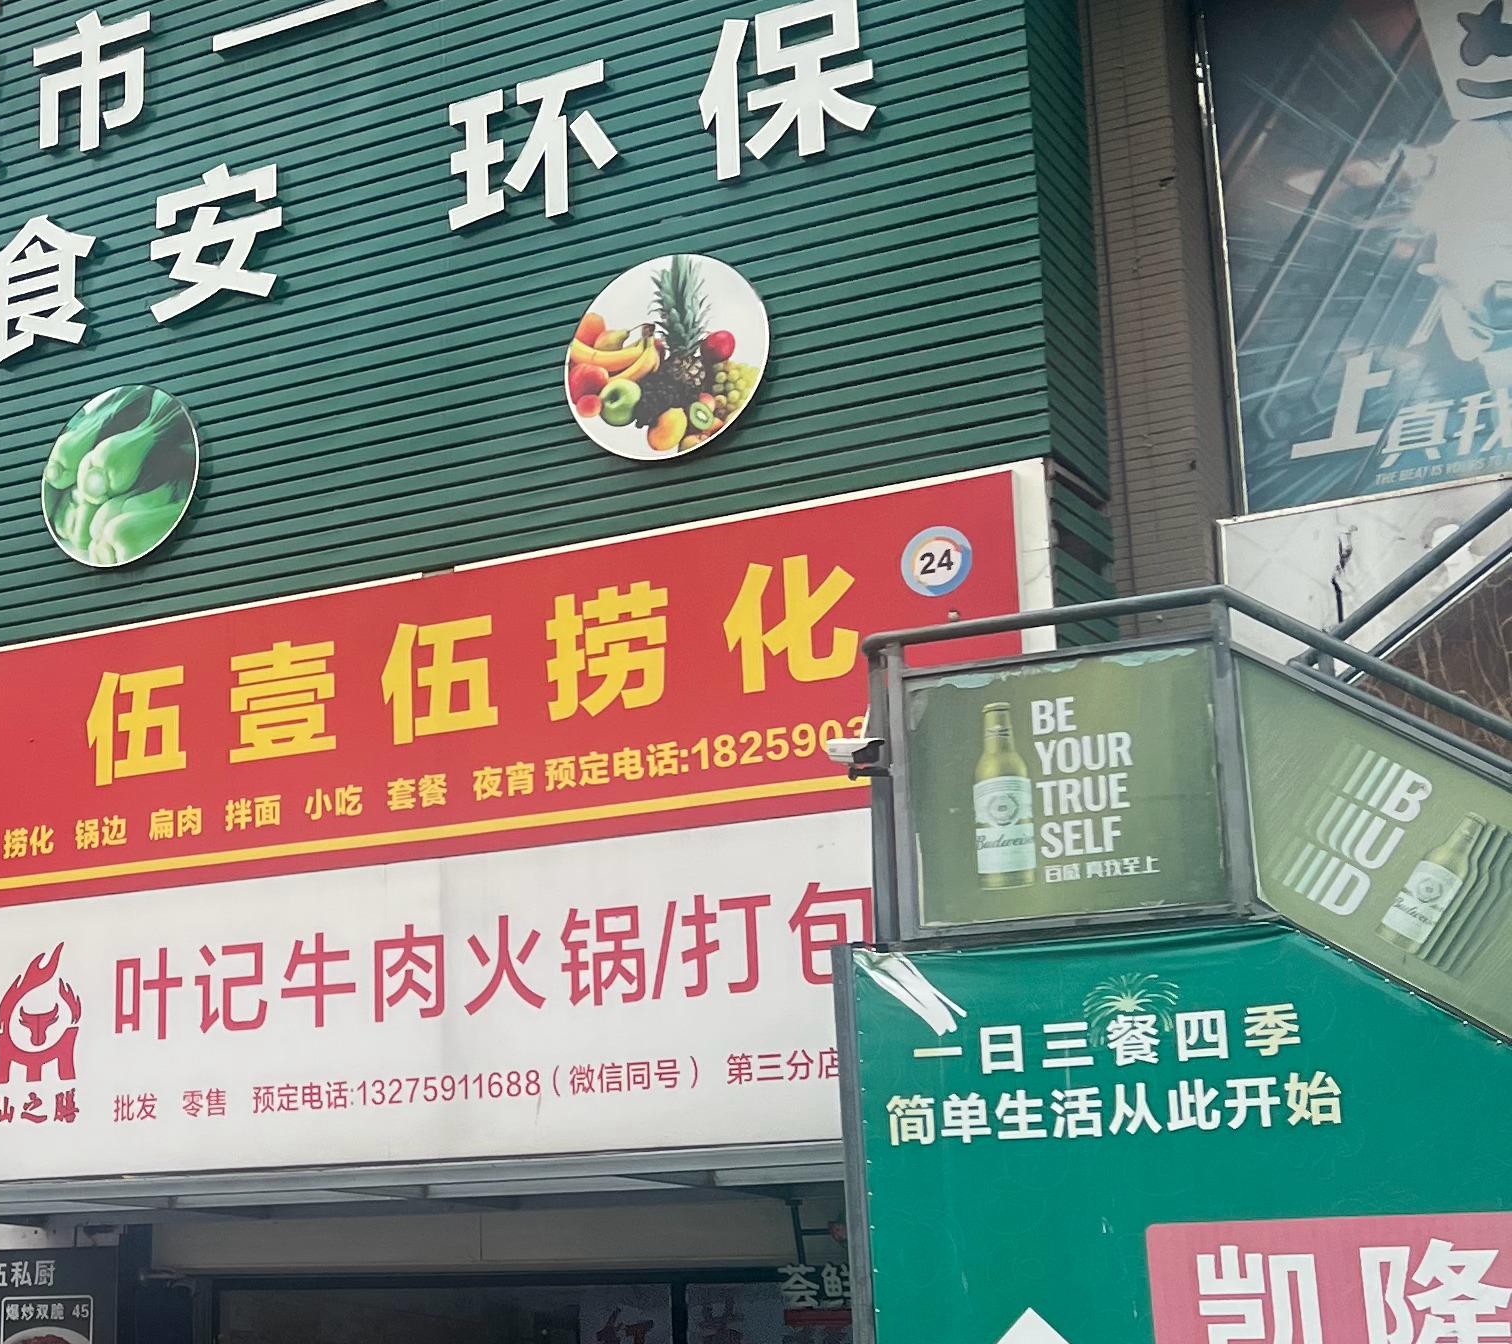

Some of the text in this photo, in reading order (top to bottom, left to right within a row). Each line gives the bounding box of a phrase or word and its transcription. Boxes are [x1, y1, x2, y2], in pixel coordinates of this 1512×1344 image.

[920, 548, 954, 575] 24
[86, 554, 859, 786] 伍壹伍捞化
[1031, 696, 1076, 735] BE
[1034, 732, 1133, 775] YOUR
[3, 825, 54, 859] 捞化
[75, 814, 127, 850] 锅边
[149, 805, 202, 840] 扁肉
[225, 794, 281, 832] 拌面
[305, 784, 363, 821] 小吃
[387, 773, 447, 810] 套餐
[472, 761, 535, 801] 夜宵
[1036, 773, 1130, 816] TRUE
[1040, 816, 1122, 858] SELF
[914, 1003, 1301, 1074] 一日三餐四季
[113, 1093, 157, 1122] 批发
[183, 1088, 227, 1118] 零售
[886, 1070, 1342, 1146] 简单生活从此开始
[72, 1304, 89, 1318] 45
